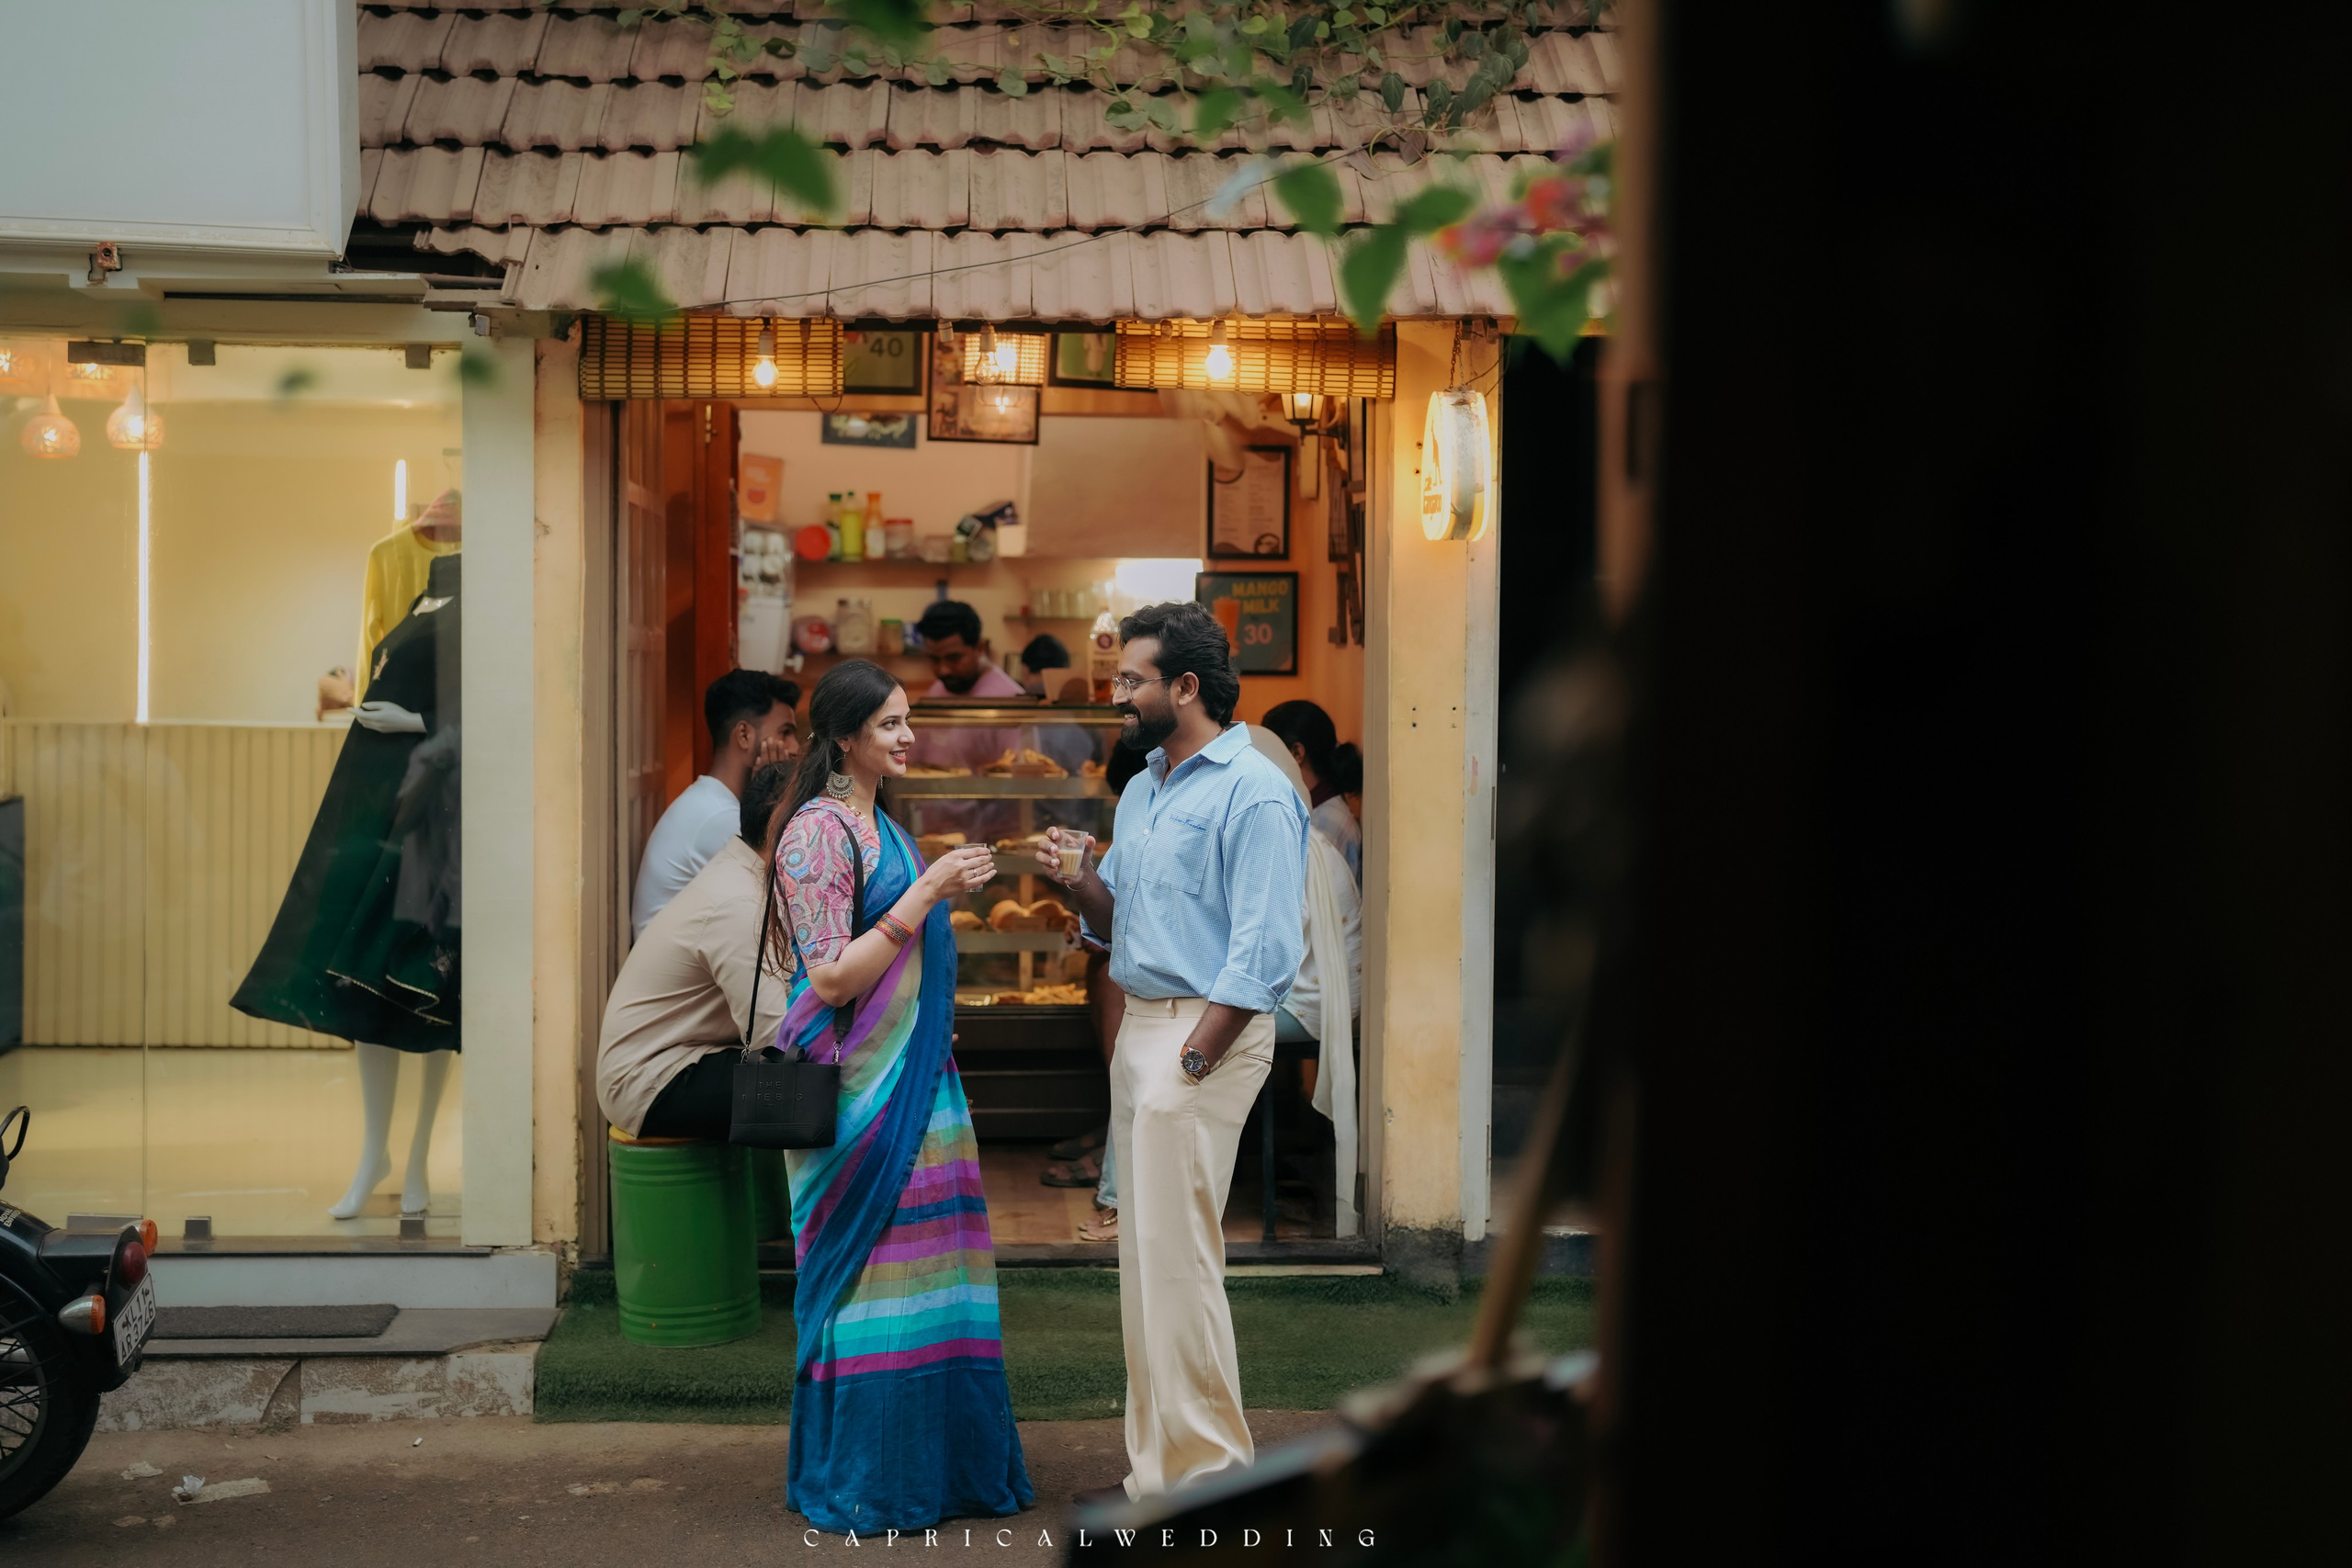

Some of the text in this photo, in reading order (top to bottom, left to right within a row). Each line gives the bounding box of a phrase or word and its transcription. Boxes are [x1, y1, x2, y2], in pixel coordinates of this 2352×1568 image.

[869, 337, 903, 357] 40
[1232, 581, 1288, 596] MANGO
[1242, 599, 1280, 614] MILK
[1243, 623, 1272, 645] 30
[759, 1081, 782, 1089] THE
